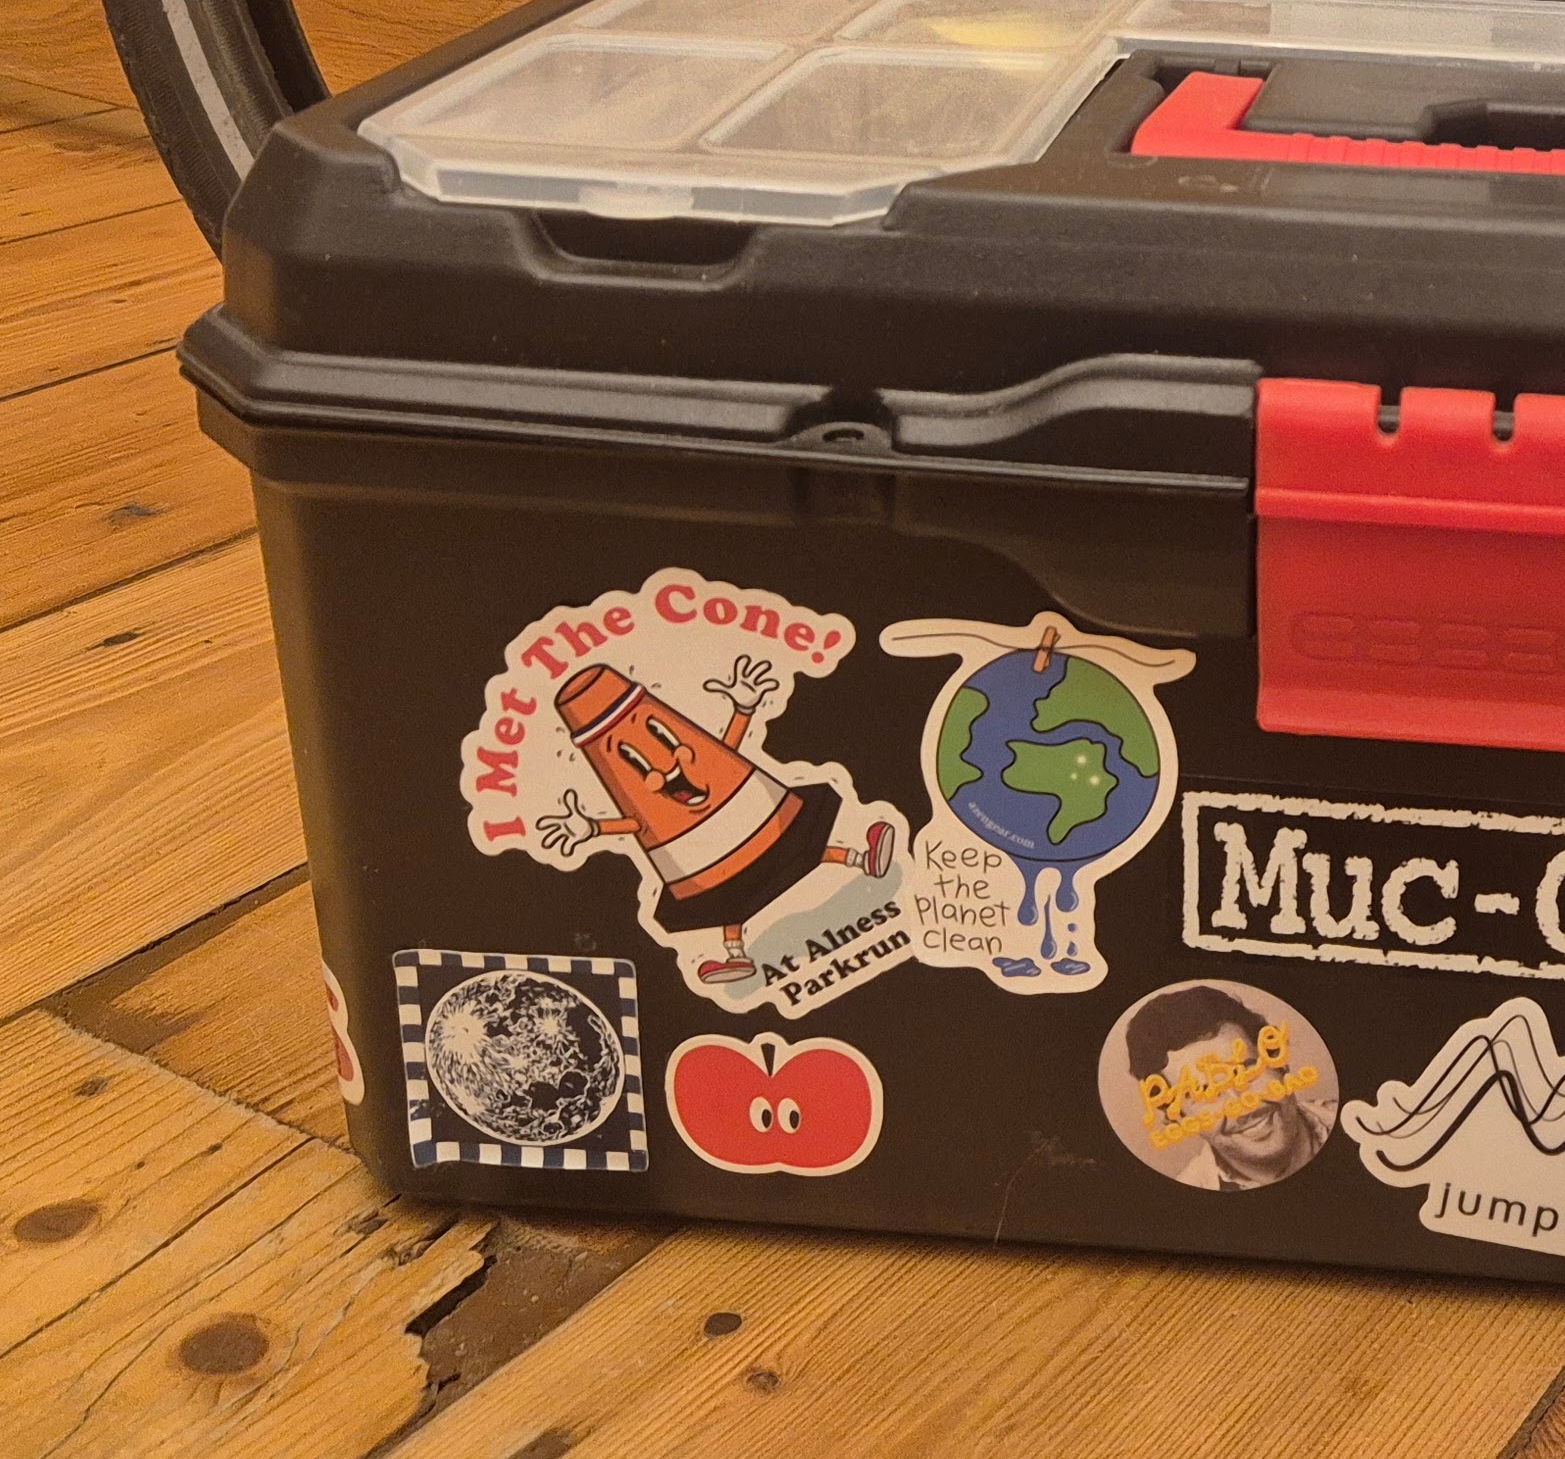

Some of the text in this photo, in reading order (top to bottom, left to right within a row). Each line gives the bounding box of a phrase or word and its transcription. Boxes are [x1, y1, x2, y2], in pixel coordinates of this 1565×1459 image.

[476, 584, 842, 841] I Met The Cone!
[924, 839, 1003, 874] Keep
[934, 874, 992, 900] the
[762, 900, 902, 987] At Alness
[780, 928, 911, 1007] Parkrun
